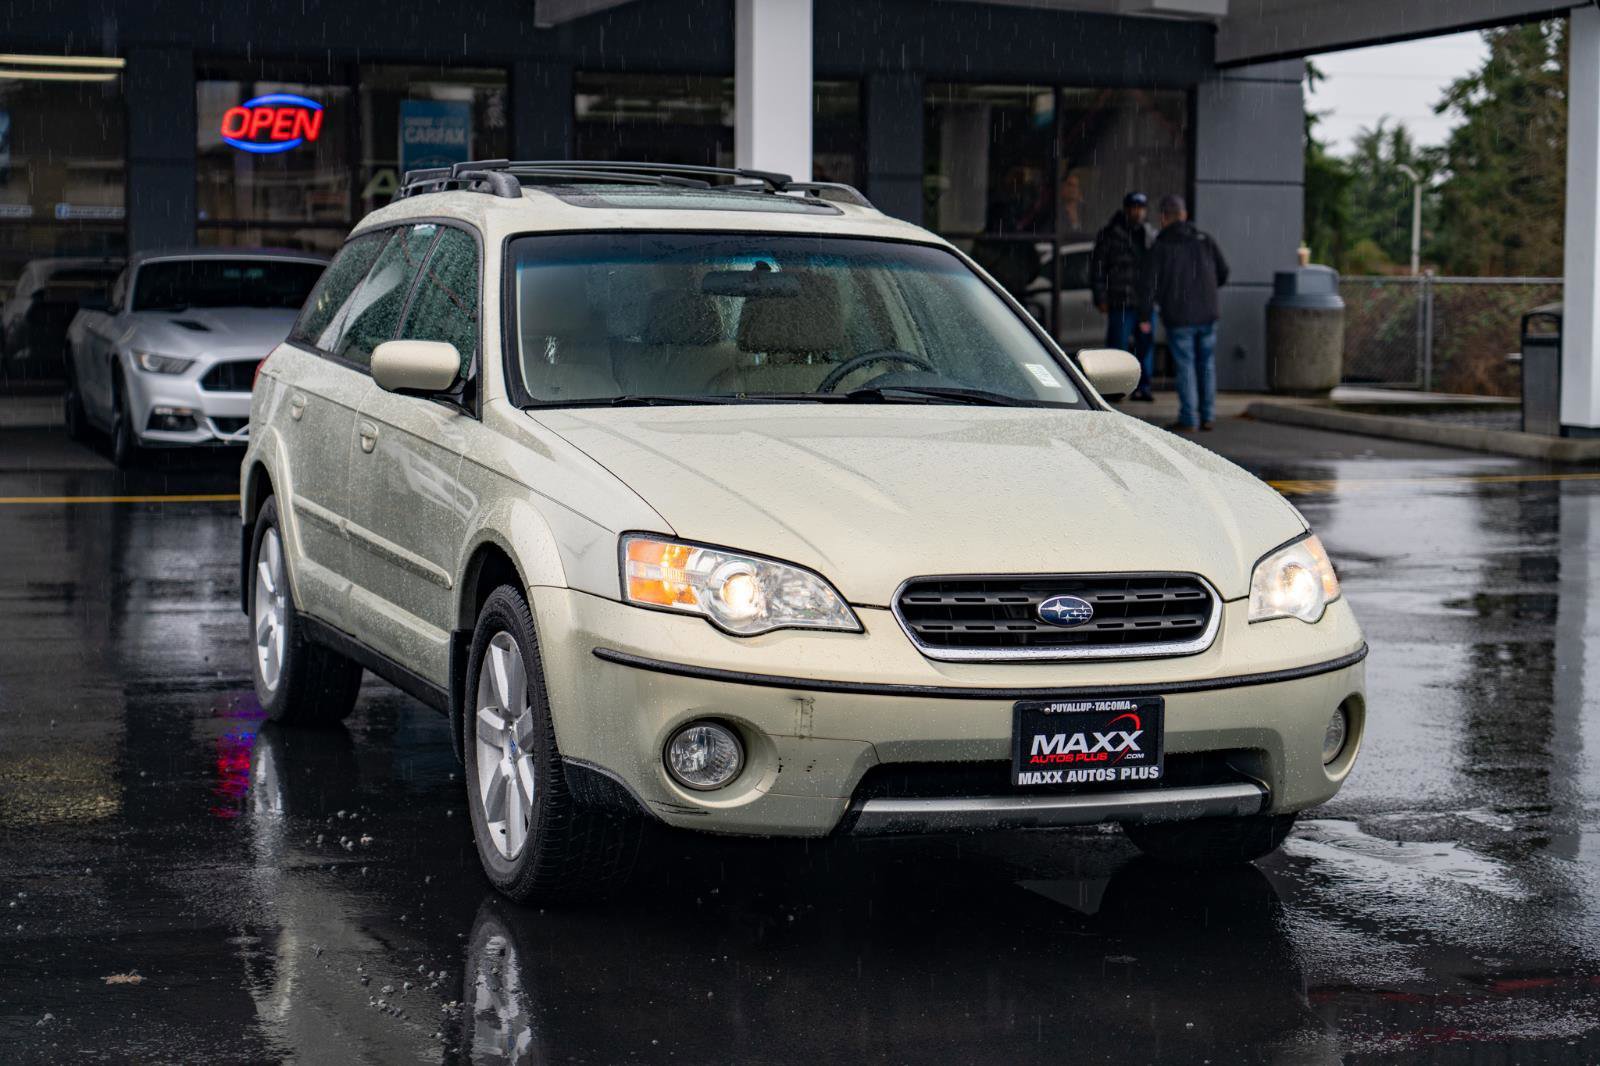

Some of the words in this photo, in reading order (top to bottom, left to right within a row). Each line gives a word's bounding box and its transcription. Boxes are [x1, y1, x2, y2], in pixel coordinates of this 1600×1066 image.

[221, 106, 323, 142] OPEN
[404, 127, 465, 144] CARFAX
[1030, 730, 1144, 756] MAXX
[1030, 753, 1074, 764] AUTOS
[1075, 752, 1109, 762] PLUS
[1018, 771, 1063, 785] MAXX
[1066, 769, 1116, 783] AUTOS
[1120, 766, 1159, 780] PLUS
